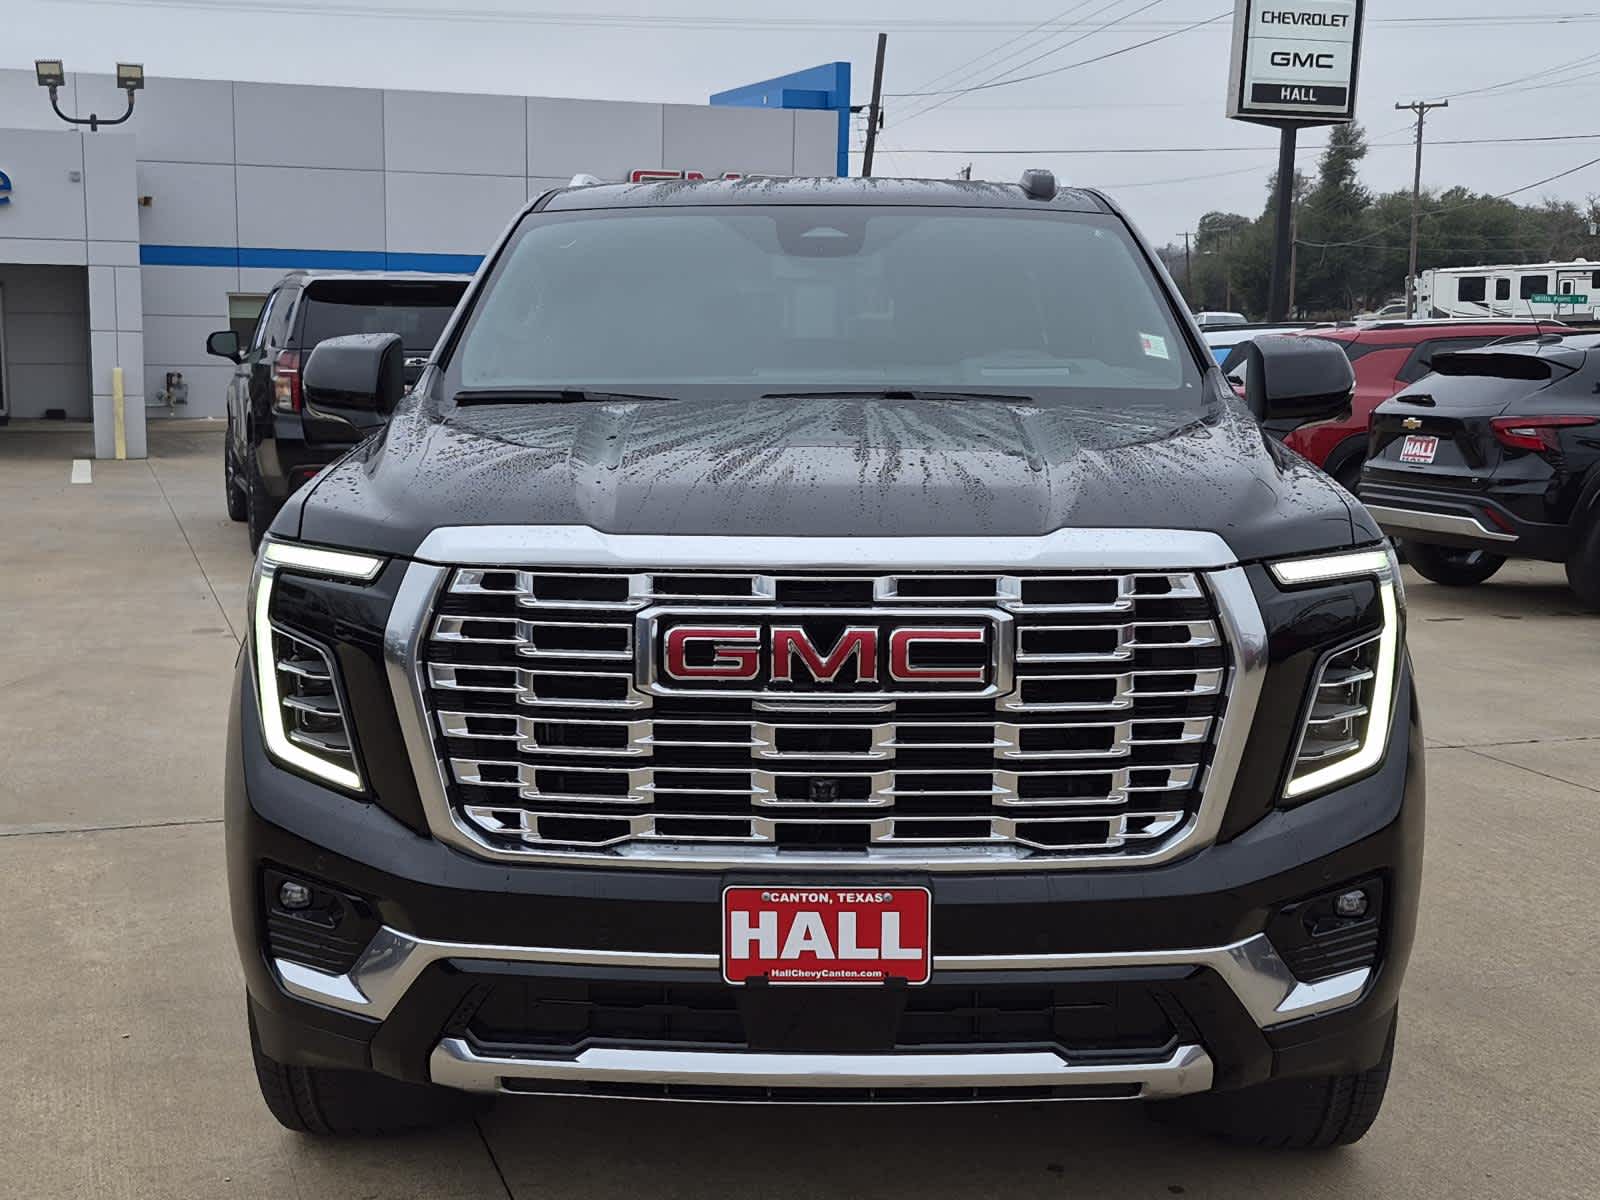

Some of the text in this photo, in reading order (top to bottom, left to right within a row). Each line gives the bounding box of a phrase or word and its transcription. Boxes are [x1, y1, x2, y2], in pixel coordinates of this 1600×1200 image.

[1261, 11, 1349, 27] CHEVROLET
[1270, 52, 1334, 69] GMC
[1280, 87, 1317, 101] HALL
[1404, 441, 1433, 456] HALL
[664, 624, 985, 683] GMC
[771, 893, 883, 904] CANTON, TEXAS
[730, 911, 922, 960] HALL
[771, 969, 882, 979] HallChevyCanton.com
